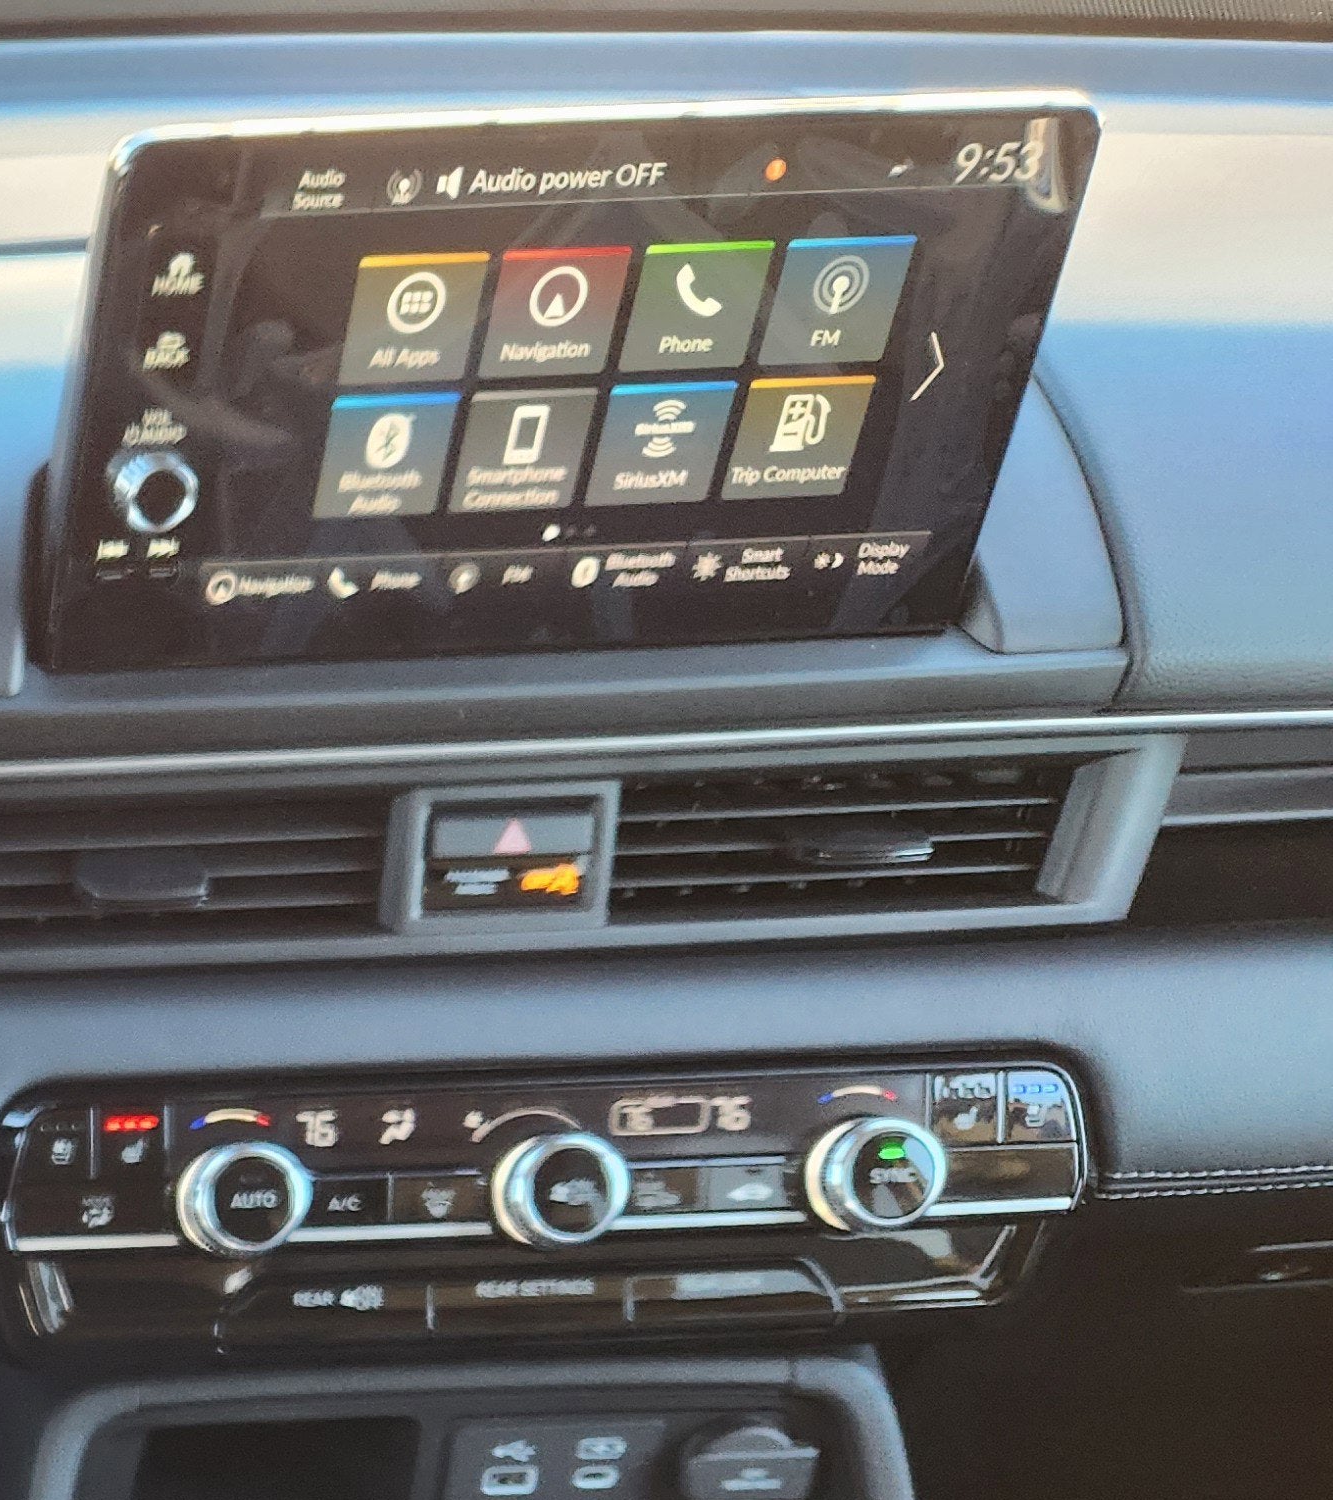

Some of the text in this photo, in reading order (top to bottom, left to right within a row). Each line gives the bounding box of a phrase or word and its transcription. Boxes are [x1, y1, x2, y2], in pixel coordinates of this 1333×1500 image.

[952, 141, 1044, 185] 9:53
[468, 162, 668, 196] Audio power OFF
[658, 334, 713, 354] Phone
[810, 329, 841, 347] FM
[368, 347, 440, 370] All Apps
[500, 339, 591, 364] Navigation
[613, 469, 689, 491] SiriusXM
[731, 463, 849, 487] Trip Computer
[857, 541, 911, 560] Display
[855, 558, 901, 577] Mode
[230, 1189, 280, 1209] AUTO
[327, 1193, 362, 1212] A/C
